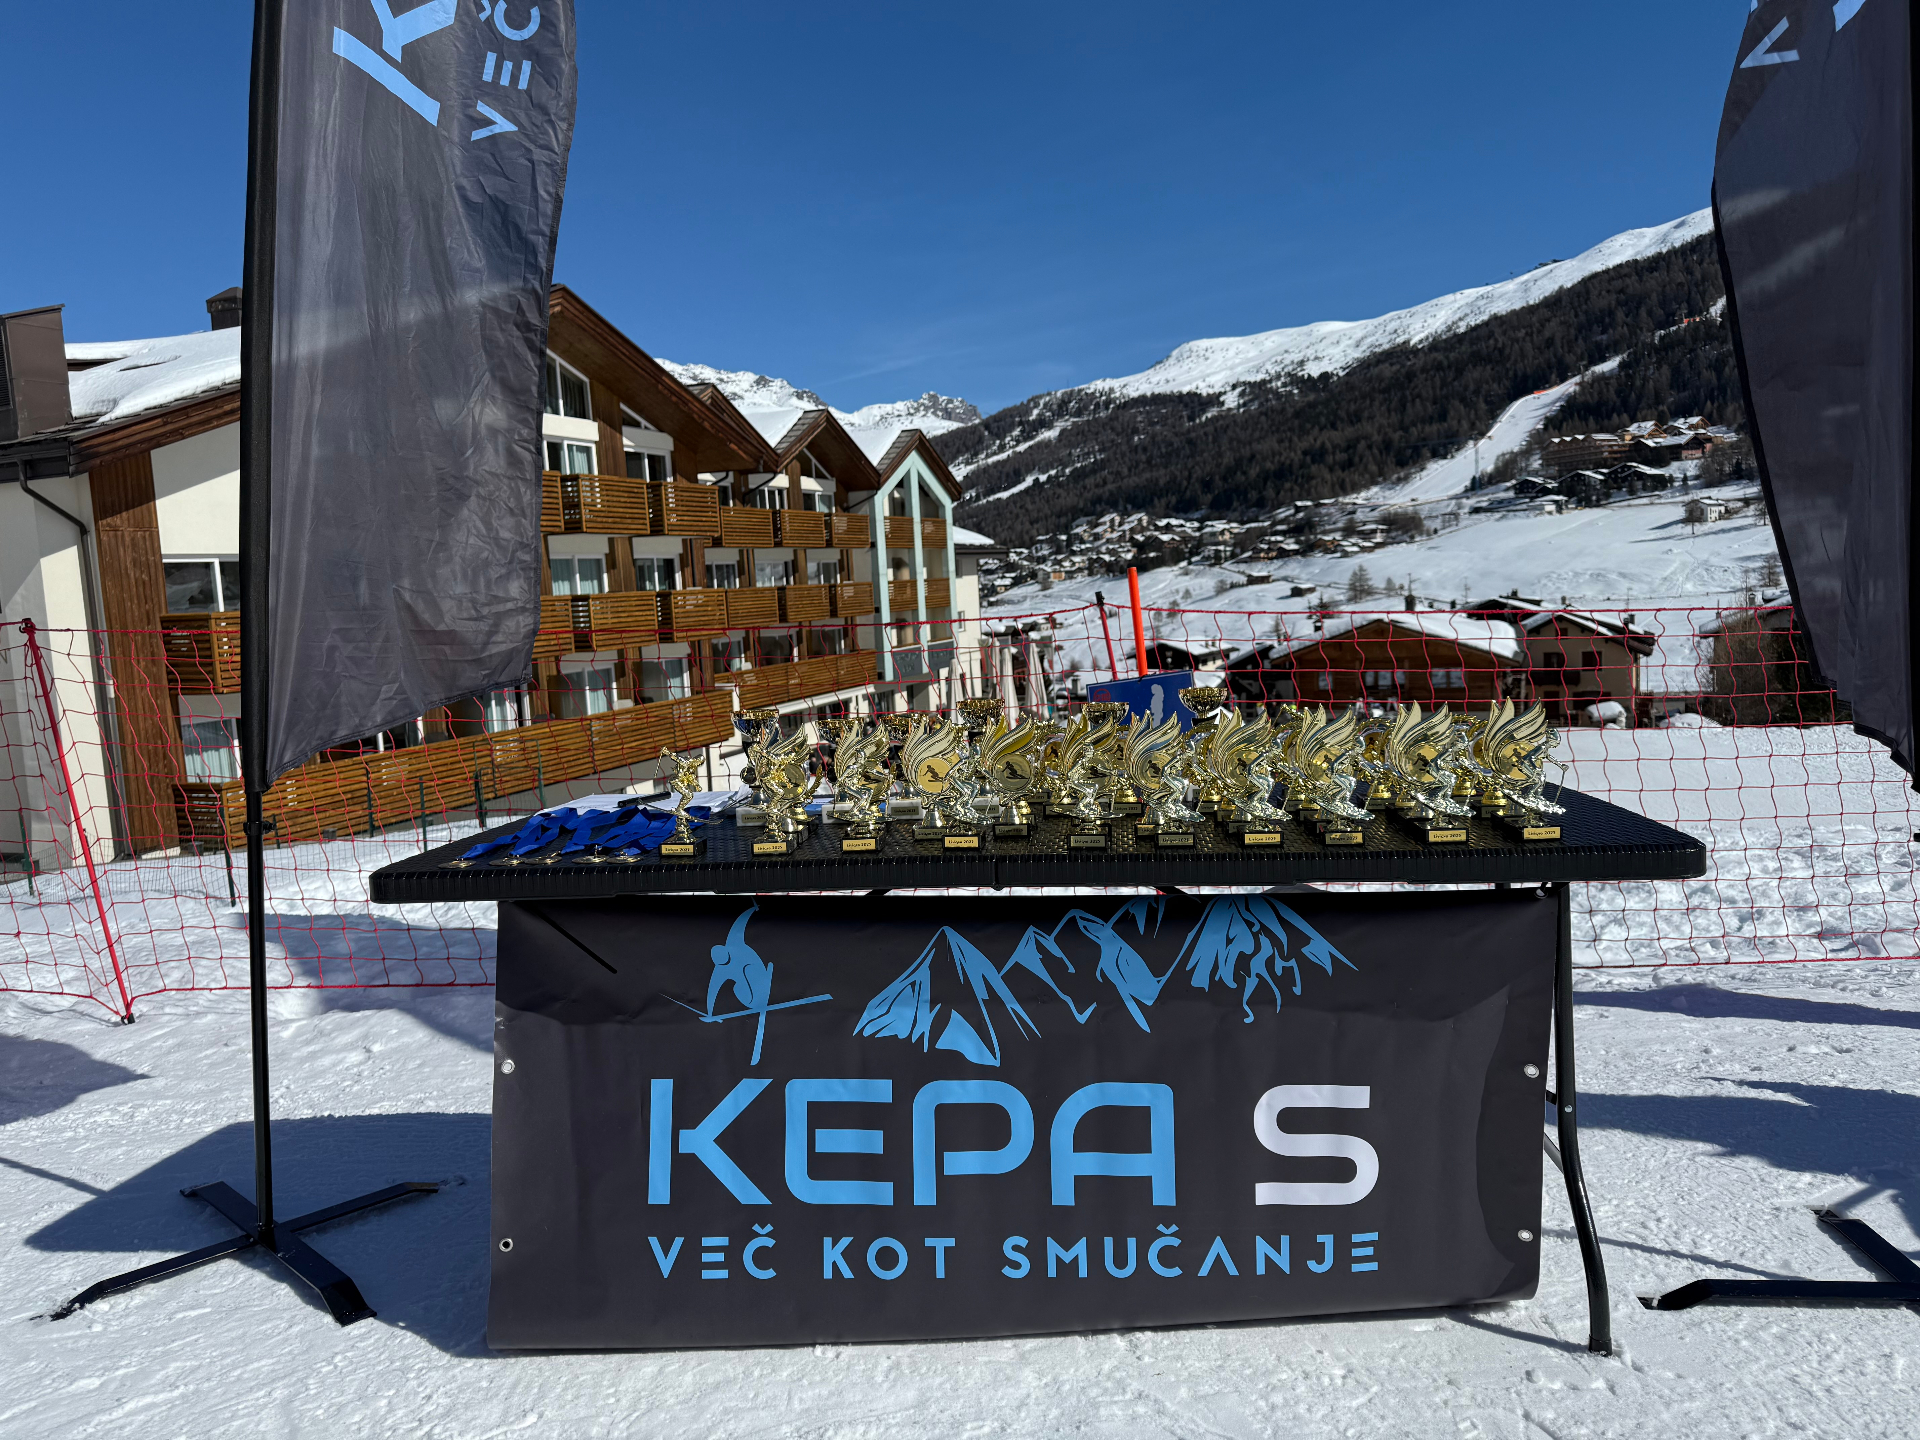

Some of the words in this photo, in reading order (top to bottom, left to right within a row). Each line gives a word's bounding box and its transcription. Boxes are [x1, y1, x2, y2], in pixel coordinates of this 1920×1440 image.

[647, 1078, 1176, 1206] KEPA
[1253, 1084, 1380, 1205] S
[648, 1223, 777, 1279] VEČ
[823, 1236, 956, 1279] KOT
[1001, 1223, 1379, 1279] SMUČANJE
